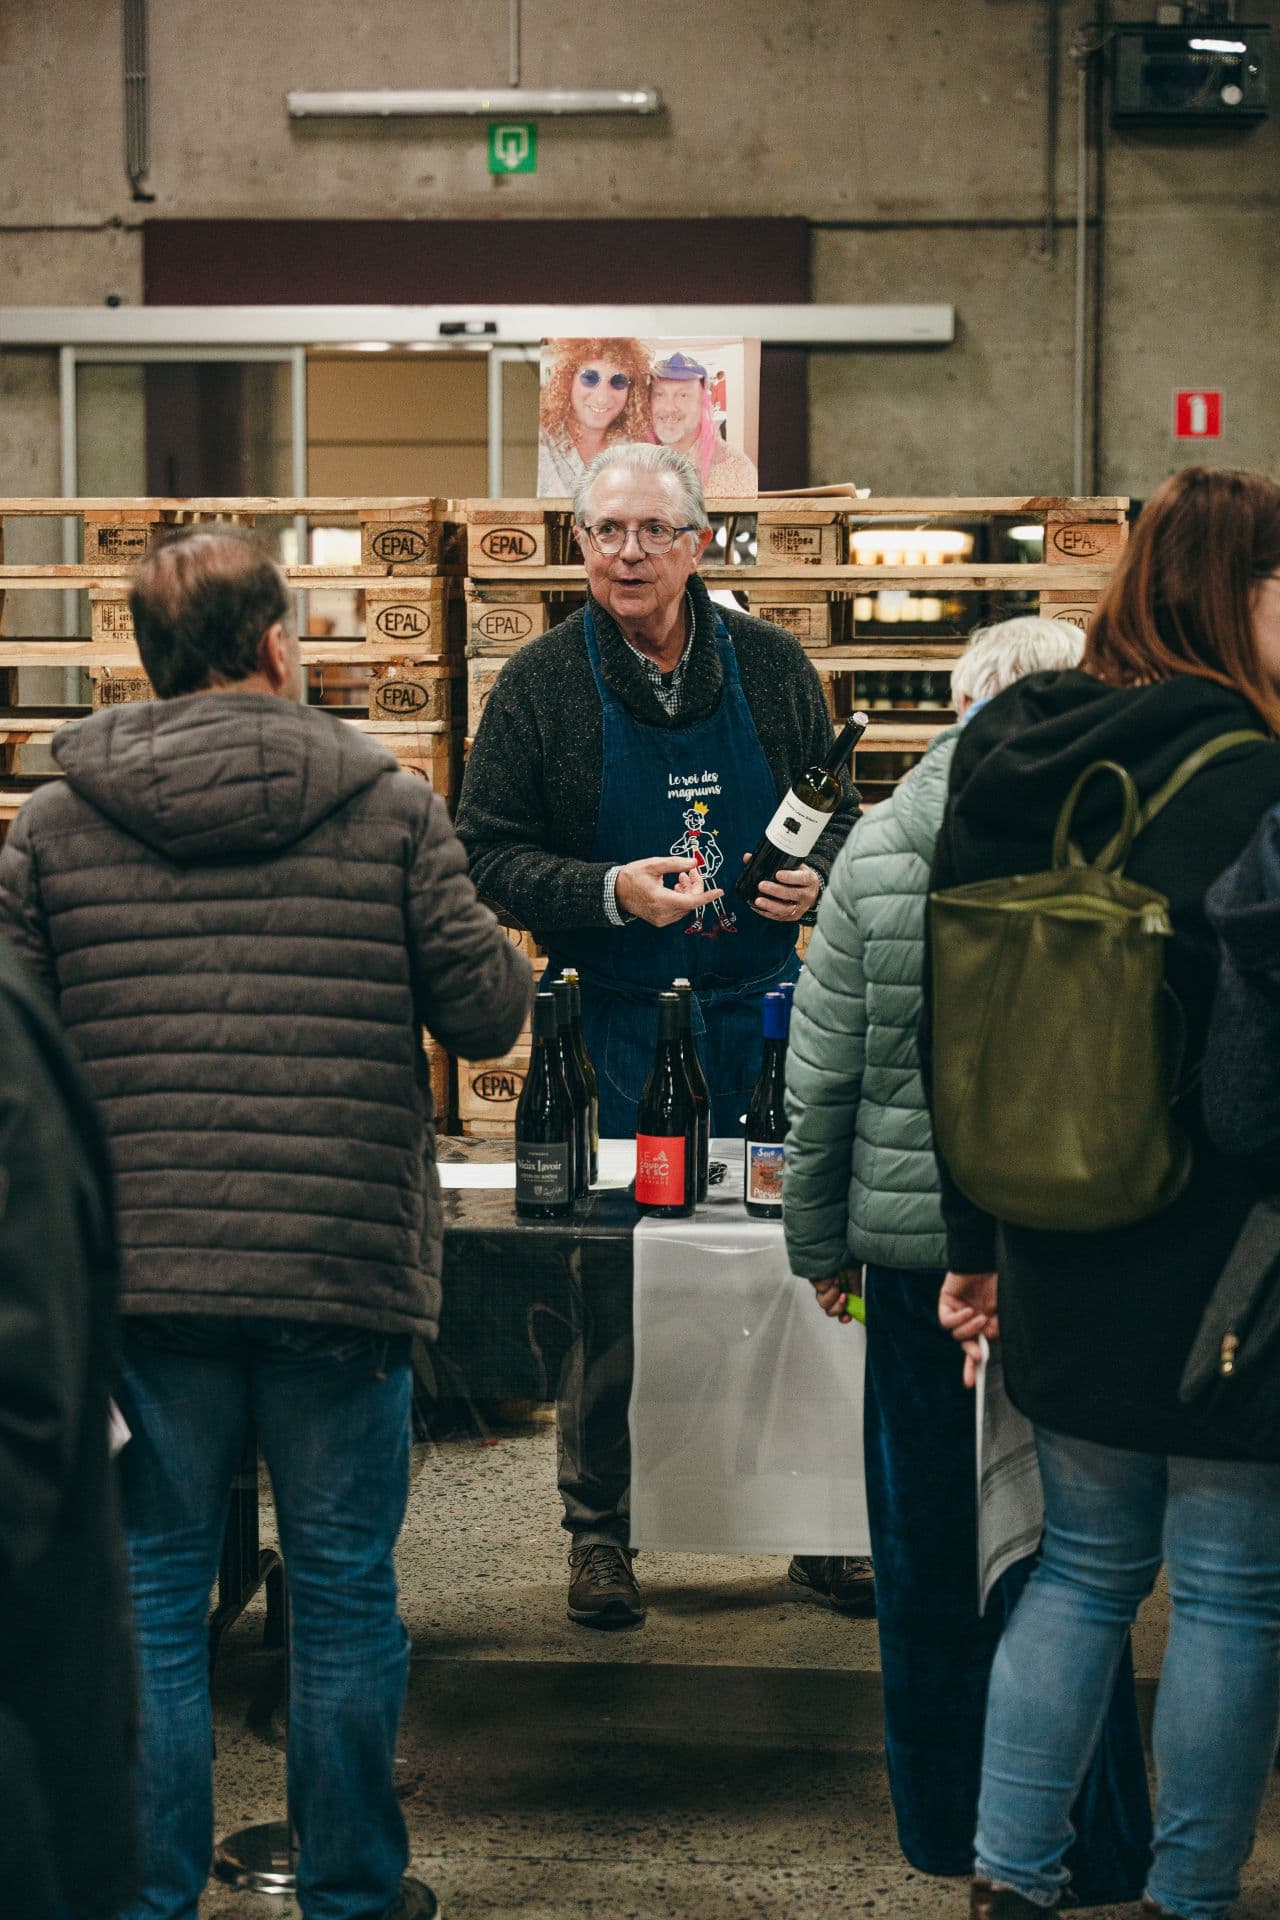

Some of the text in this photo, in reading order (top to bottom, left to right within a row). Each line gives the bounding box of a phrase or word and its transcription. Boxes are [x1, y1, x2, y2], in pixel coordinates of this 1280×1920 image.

[382, 536, 419, 555] EPAL
[489, 536, 529, 555] EPAL
[385, 613, 422, 632] EPAL
[486, 616, 525, 634] EPAL
[668, 770, 719, 786] Le roi des
[667, 785, 722, 802] magnums
[482, 1076, 518, 1096] EPAL
